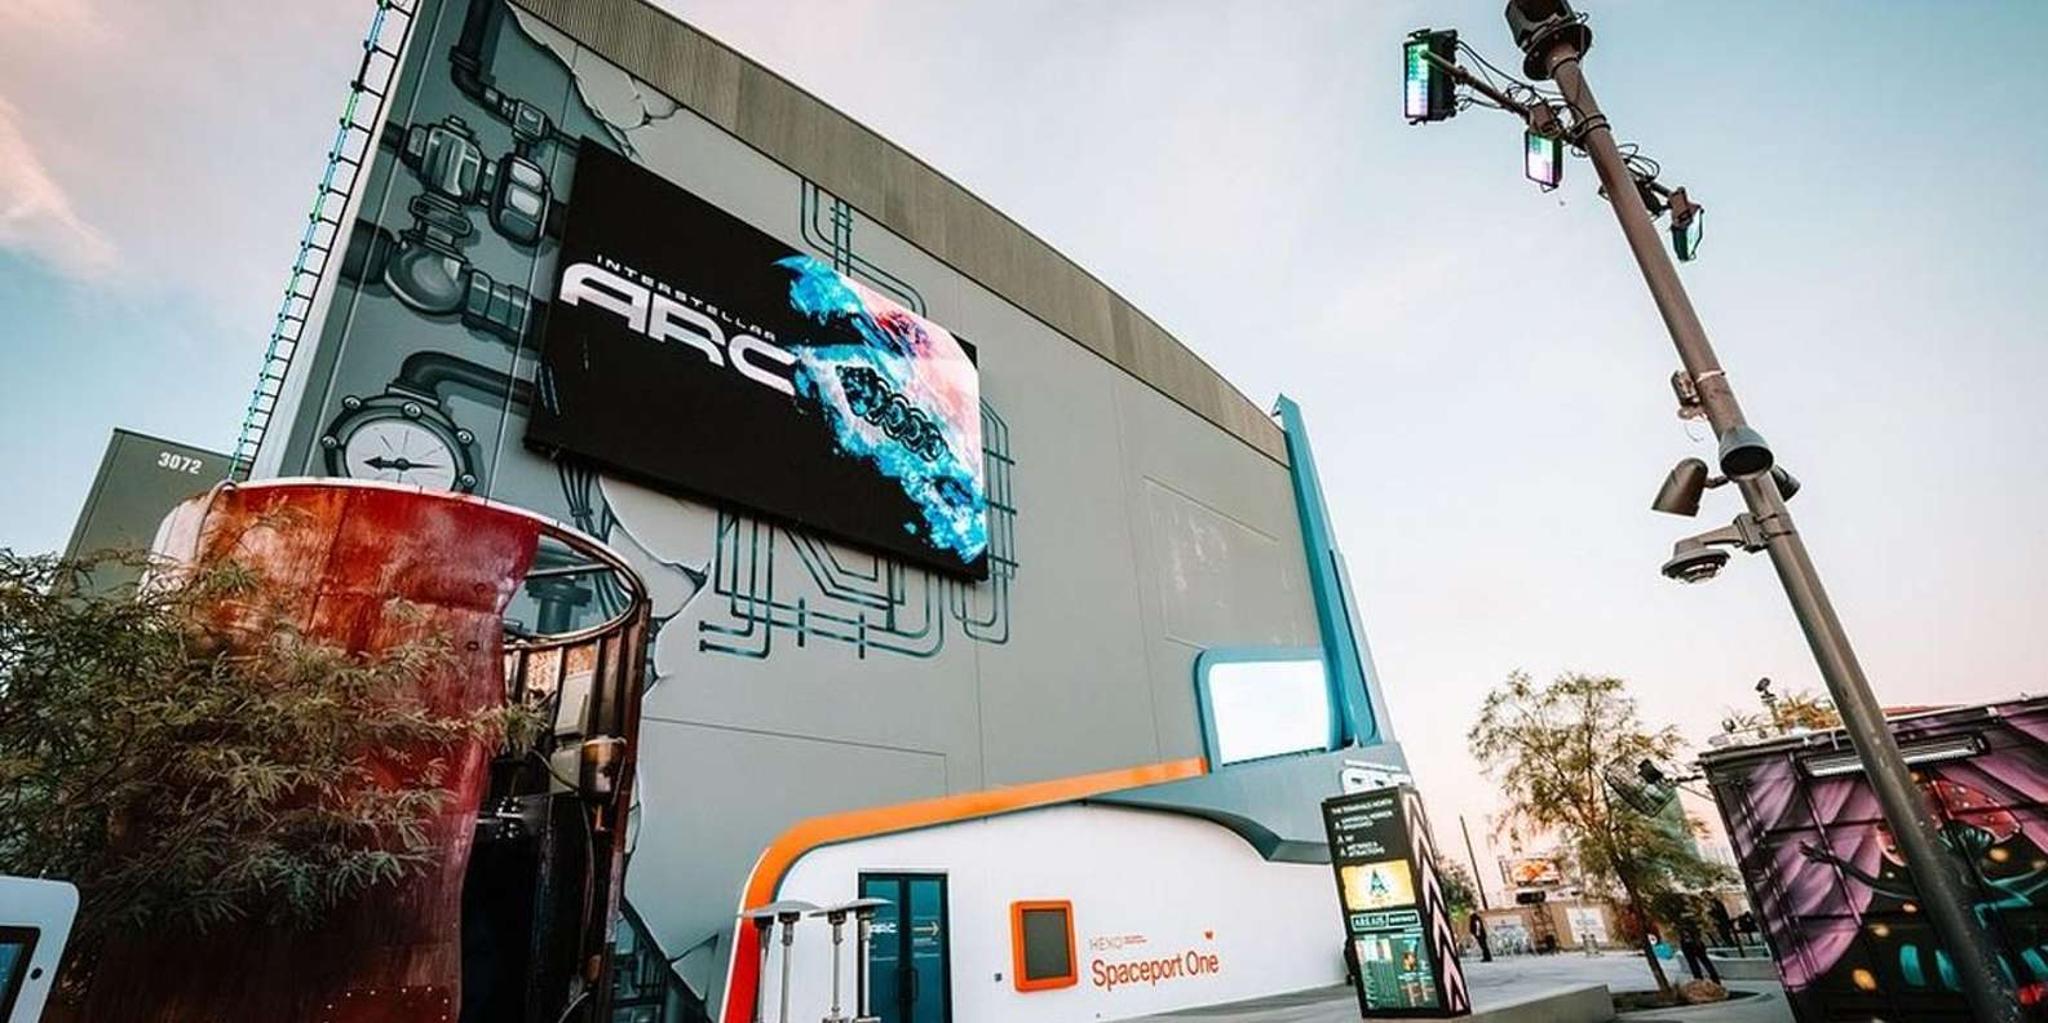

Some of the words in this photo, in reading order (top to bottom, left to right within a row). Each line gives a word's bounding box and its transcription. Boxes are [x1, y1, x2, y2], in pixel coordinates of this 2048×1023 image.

[559, 261, 797, 396] ARC
[596, 253, 777, 341] INTERSTELLAR
[157, 451, 202, 475] 3072
[1091, 954, 1184, 991] Spaceport
[1185, 950, 1219, 975] One
